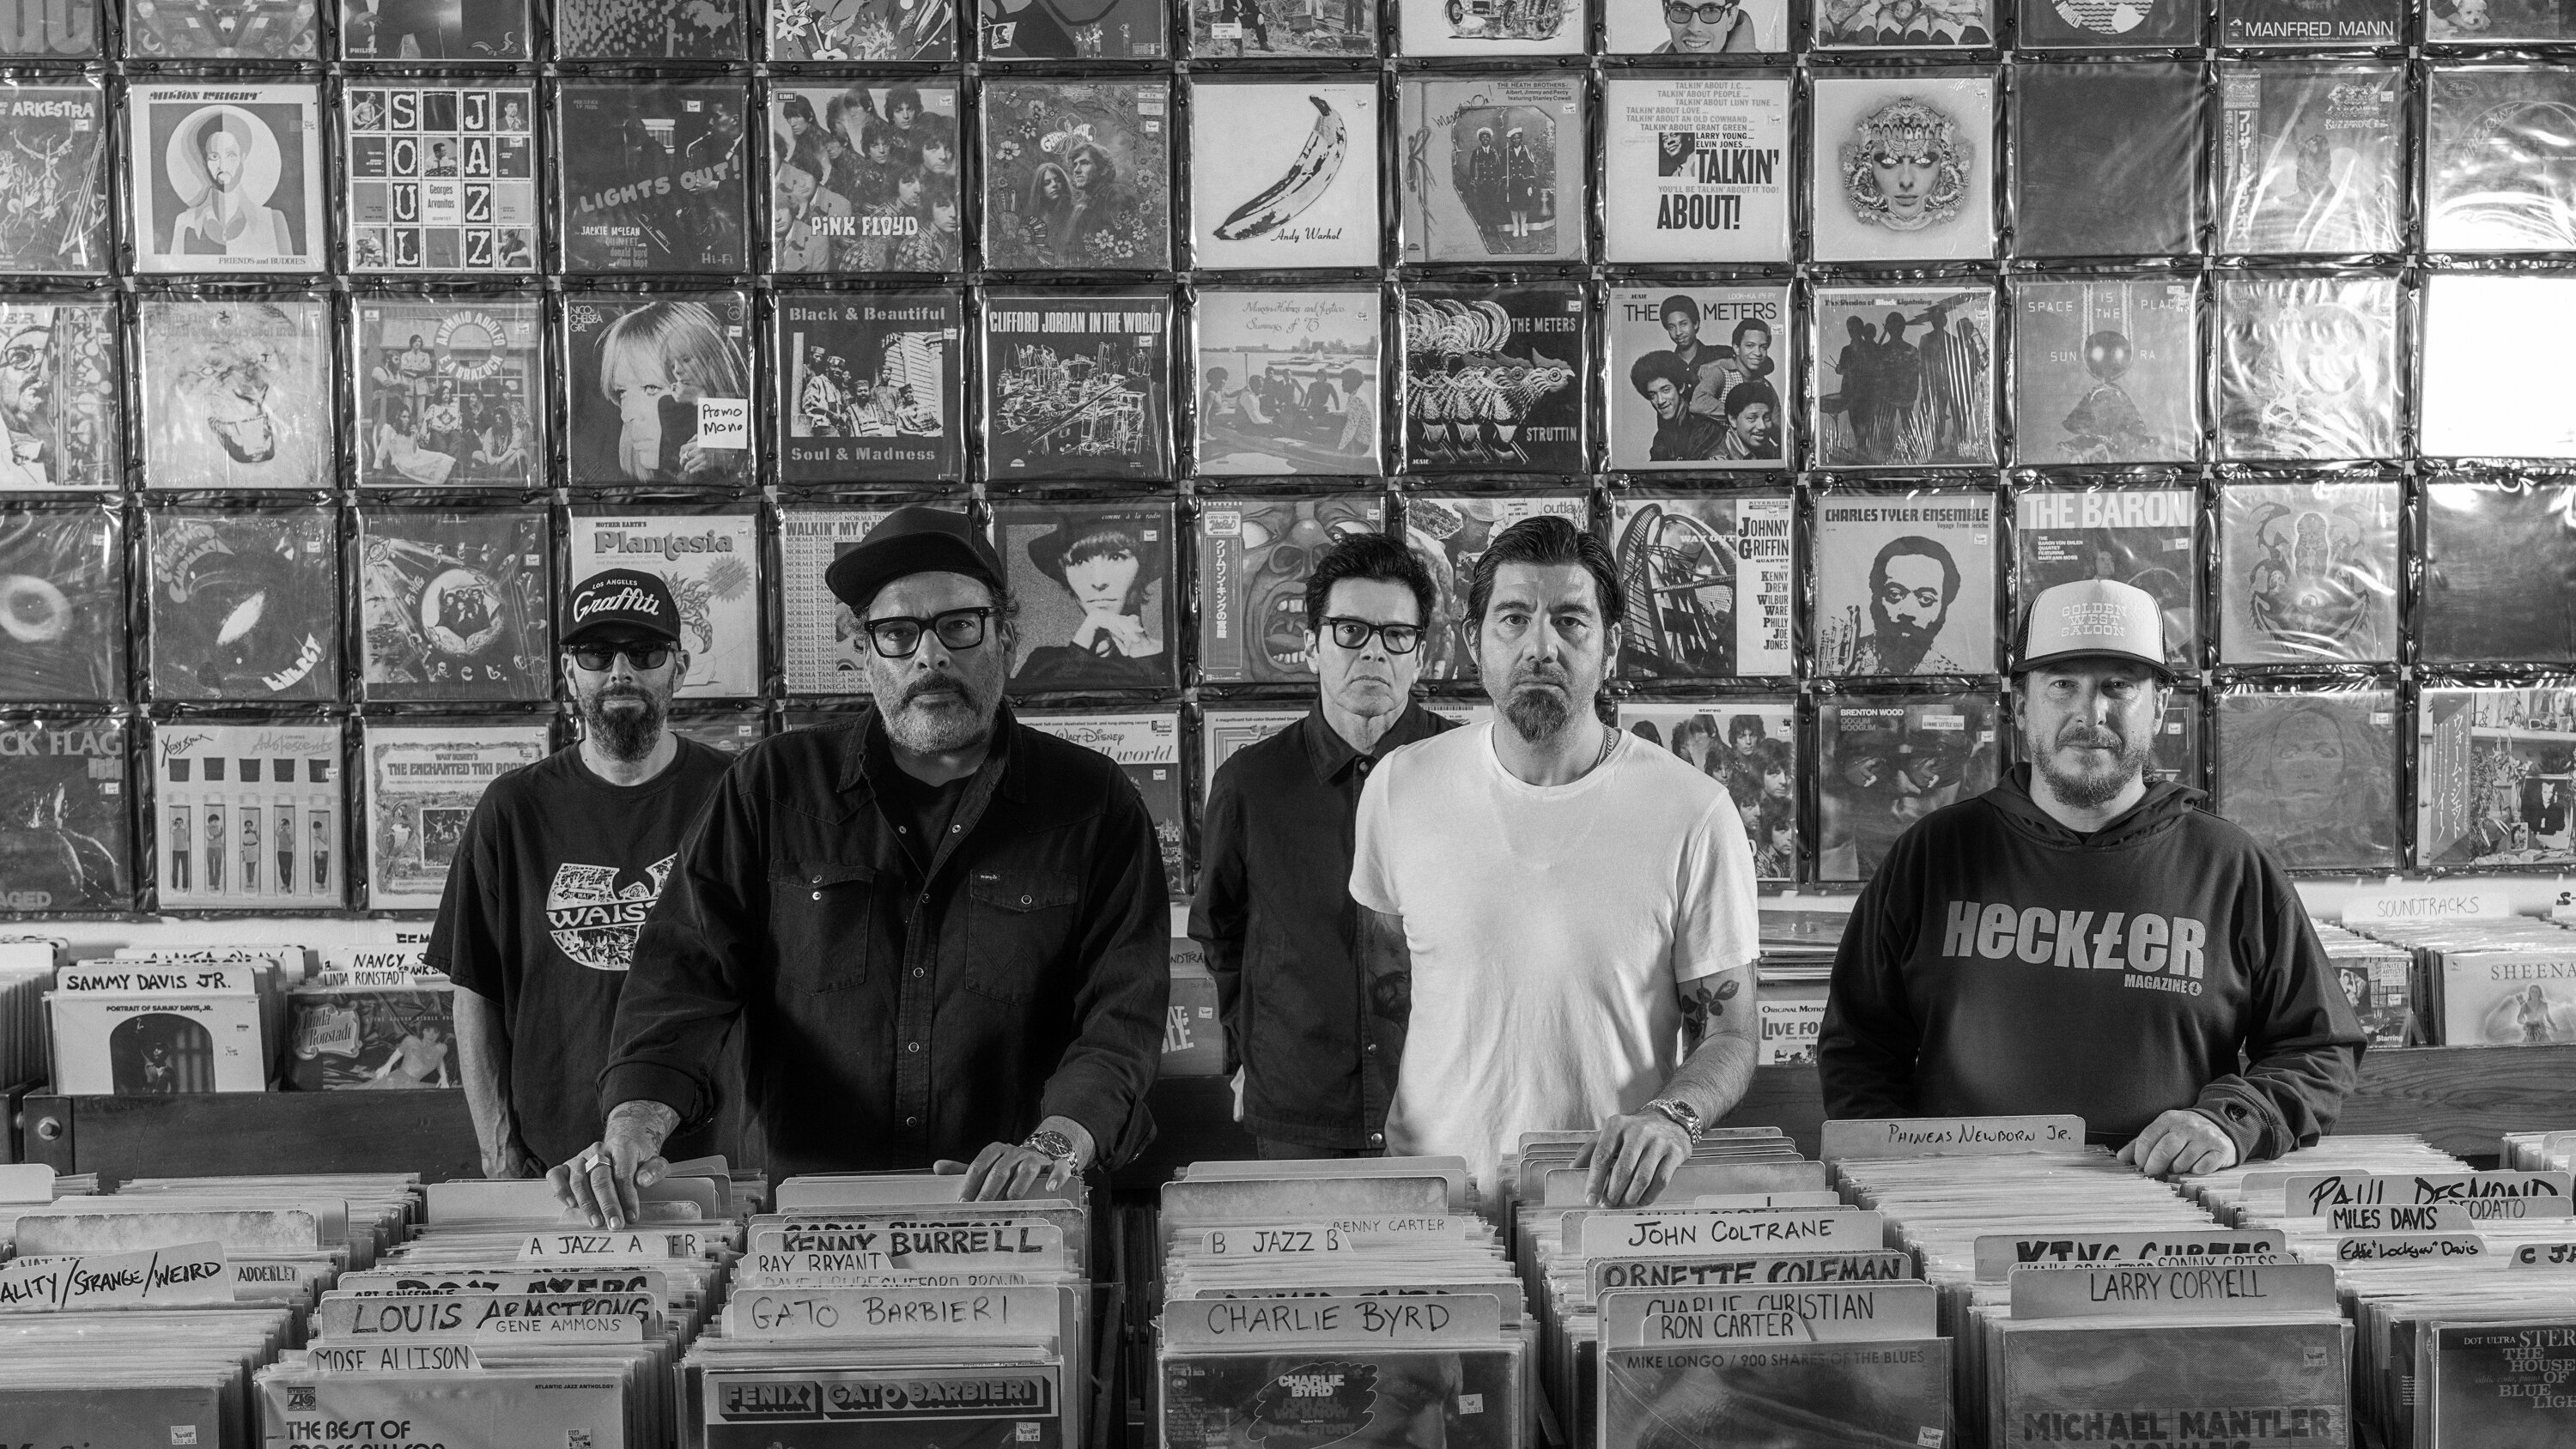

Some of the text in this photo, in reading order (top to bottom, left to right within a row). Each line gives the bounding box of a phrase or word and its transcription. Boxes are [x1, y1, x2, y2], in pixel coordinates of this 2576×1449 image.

[2245, 21, 2394, 37] MANFRED MANN
[12, 100, 95, 118] ARKESTRA
[1696, 149, 1779, 184] TALKIN'
[429, 184, 453, 195] Georges
[580, 155, 741, 213] LIGHTS OUT!
[428, 198, 455, 209] Arvanitas
[1656, 194, 1741, 230] ABOUT!
[580, 226, 608, 236] JACKIE
[861, 215, 918, 236] FLOYD
[1270, 227, 1342, 242] Andy Warhol
[218, 257, 307, 265] FRIENDS BUDDIES
[789, 306, 945, 321] Black Beautiful
[1623, 302, 1777, 321] THE METERS
[2028, 301, 2073, 312] SPACE
[569, 314, 603, 324] CHELSEA
[990, 311, 1162, 334] CLIFFORD JORDAN IN THE WORLD
[1511, 318, 1577, 333] THE METERS
[570, 323, 587, 332] GIRL
[2050, 350, 2156, 362] SUN RA
[702, 403, 743, 419] Promo
[704, 422, 743, 435] Mono
[1526, 427, 1577, 442] STRUTTIN
[791, 447, 935, 461] Soul Madness
[1543, 501, 1583, 515] outlaw
[1825, 508, 1878, 522] CHARLES
[2024, 491, 2188, 529] THE BARON
[786, 522, 859, 536] WALKIN' MY
[1738, 517, 1789, 537] JOHNNY
[594, 529, 733, 561] Plantasia
[1738, 538, 1789, 560] GRIFFIN
[1760, 571, 1789, 582] KENNY
[592, 581, 605, 590] LOS
[1765, 582, 1788, 593] DREW
[574, 586, 659, 622] Graffiti
[1757, 594, 1789, 605] WILBUR
[1765, 605, 1788, 616] WARE
[2062, 603, 2127, 617] GOLDEN
[1763, 617, 1789, 628] PHILLY
[2069, 614, 2120, 626] WEST
[1773, 628, 1788, 640] JOE
[2061, 625, 2125, 637] SALOON
[1764, 640, 1789, 650] JONES
[262, 632, 322, 692] ENERGY
[50, 730, 123, 756] FLAG
[1116, 745, 1173, 762] world
[388, 762, 493, 776] THE ENCHANTED TIKI
[546, 901, 657, 929] WAIS
[2377, 896, 2479, 919] SOUNDTRACKS
[353, 954, 405, 968] NANCY
[66, 973, 231, 992] SAMMY DAVIS JR.
[324, 971, 406, 986] LINDA RONSTADT
[2123, 974, 2187, 993] MAGAZINE
[309, 1028, 352, 1046] Ronstadt
[1888, 1124, 2036, 1143] PHINEAS NEWBORN
[1388, 1218, 1445, 1231] CARTER
[2333, 1206, 2438, 1230] MILES DAVIS
[1628, 1219, 1835, 1246] JOHN COLTRANE
[558, 1235, 615, 1254] JAZZ
[782, 1227, 1043, 1258] KENNY BURRELL
[1252, 1231, 1313, 1252] JAZZ
[2441, 1241, 2478, 1256] Davis
[759, 1252, 881, 1272] RAY BRYANT
[1604, 1258, 1901, 1287] ORNETTE COLEMAN
[2090, 1269, 2268, 1301] LARRY CORYELL
[352, 1302, 463, 1334] LOUIS
[752, 1294, 1008, 1330] GATO BARBIERI
[1207, 1301, 1450, 1337] CHARLIE BYRD
[495, 1318, 622, 1333] GENE AMMONS
[1661, 1313, 1794, 1339] RON CARTER
[2464, 1336, 2516, 1345] DOT ULTRA
[380, 1345, 470, 1371] ALLISON
[1627, 1350, 1924, 1369] MIKE LONGO 900 THE BLUES
[2502, 1347, 2544, 1361] THE
[2510, 1359, 2576, 1373] HOUSE
[1278, 1374, 1345, 1387] CHARLIE
[724, 1379, 1033, 1410] FENIX BARBIERI
[1291, 1385, 1334, 1397] BYRD
[2499, 1383, 2551, 1397] BLUE
[286, 1421, 410, 1440] THE BEST OF
[2024, 1408, 2331, 1443] MICHAEL MANTLER
